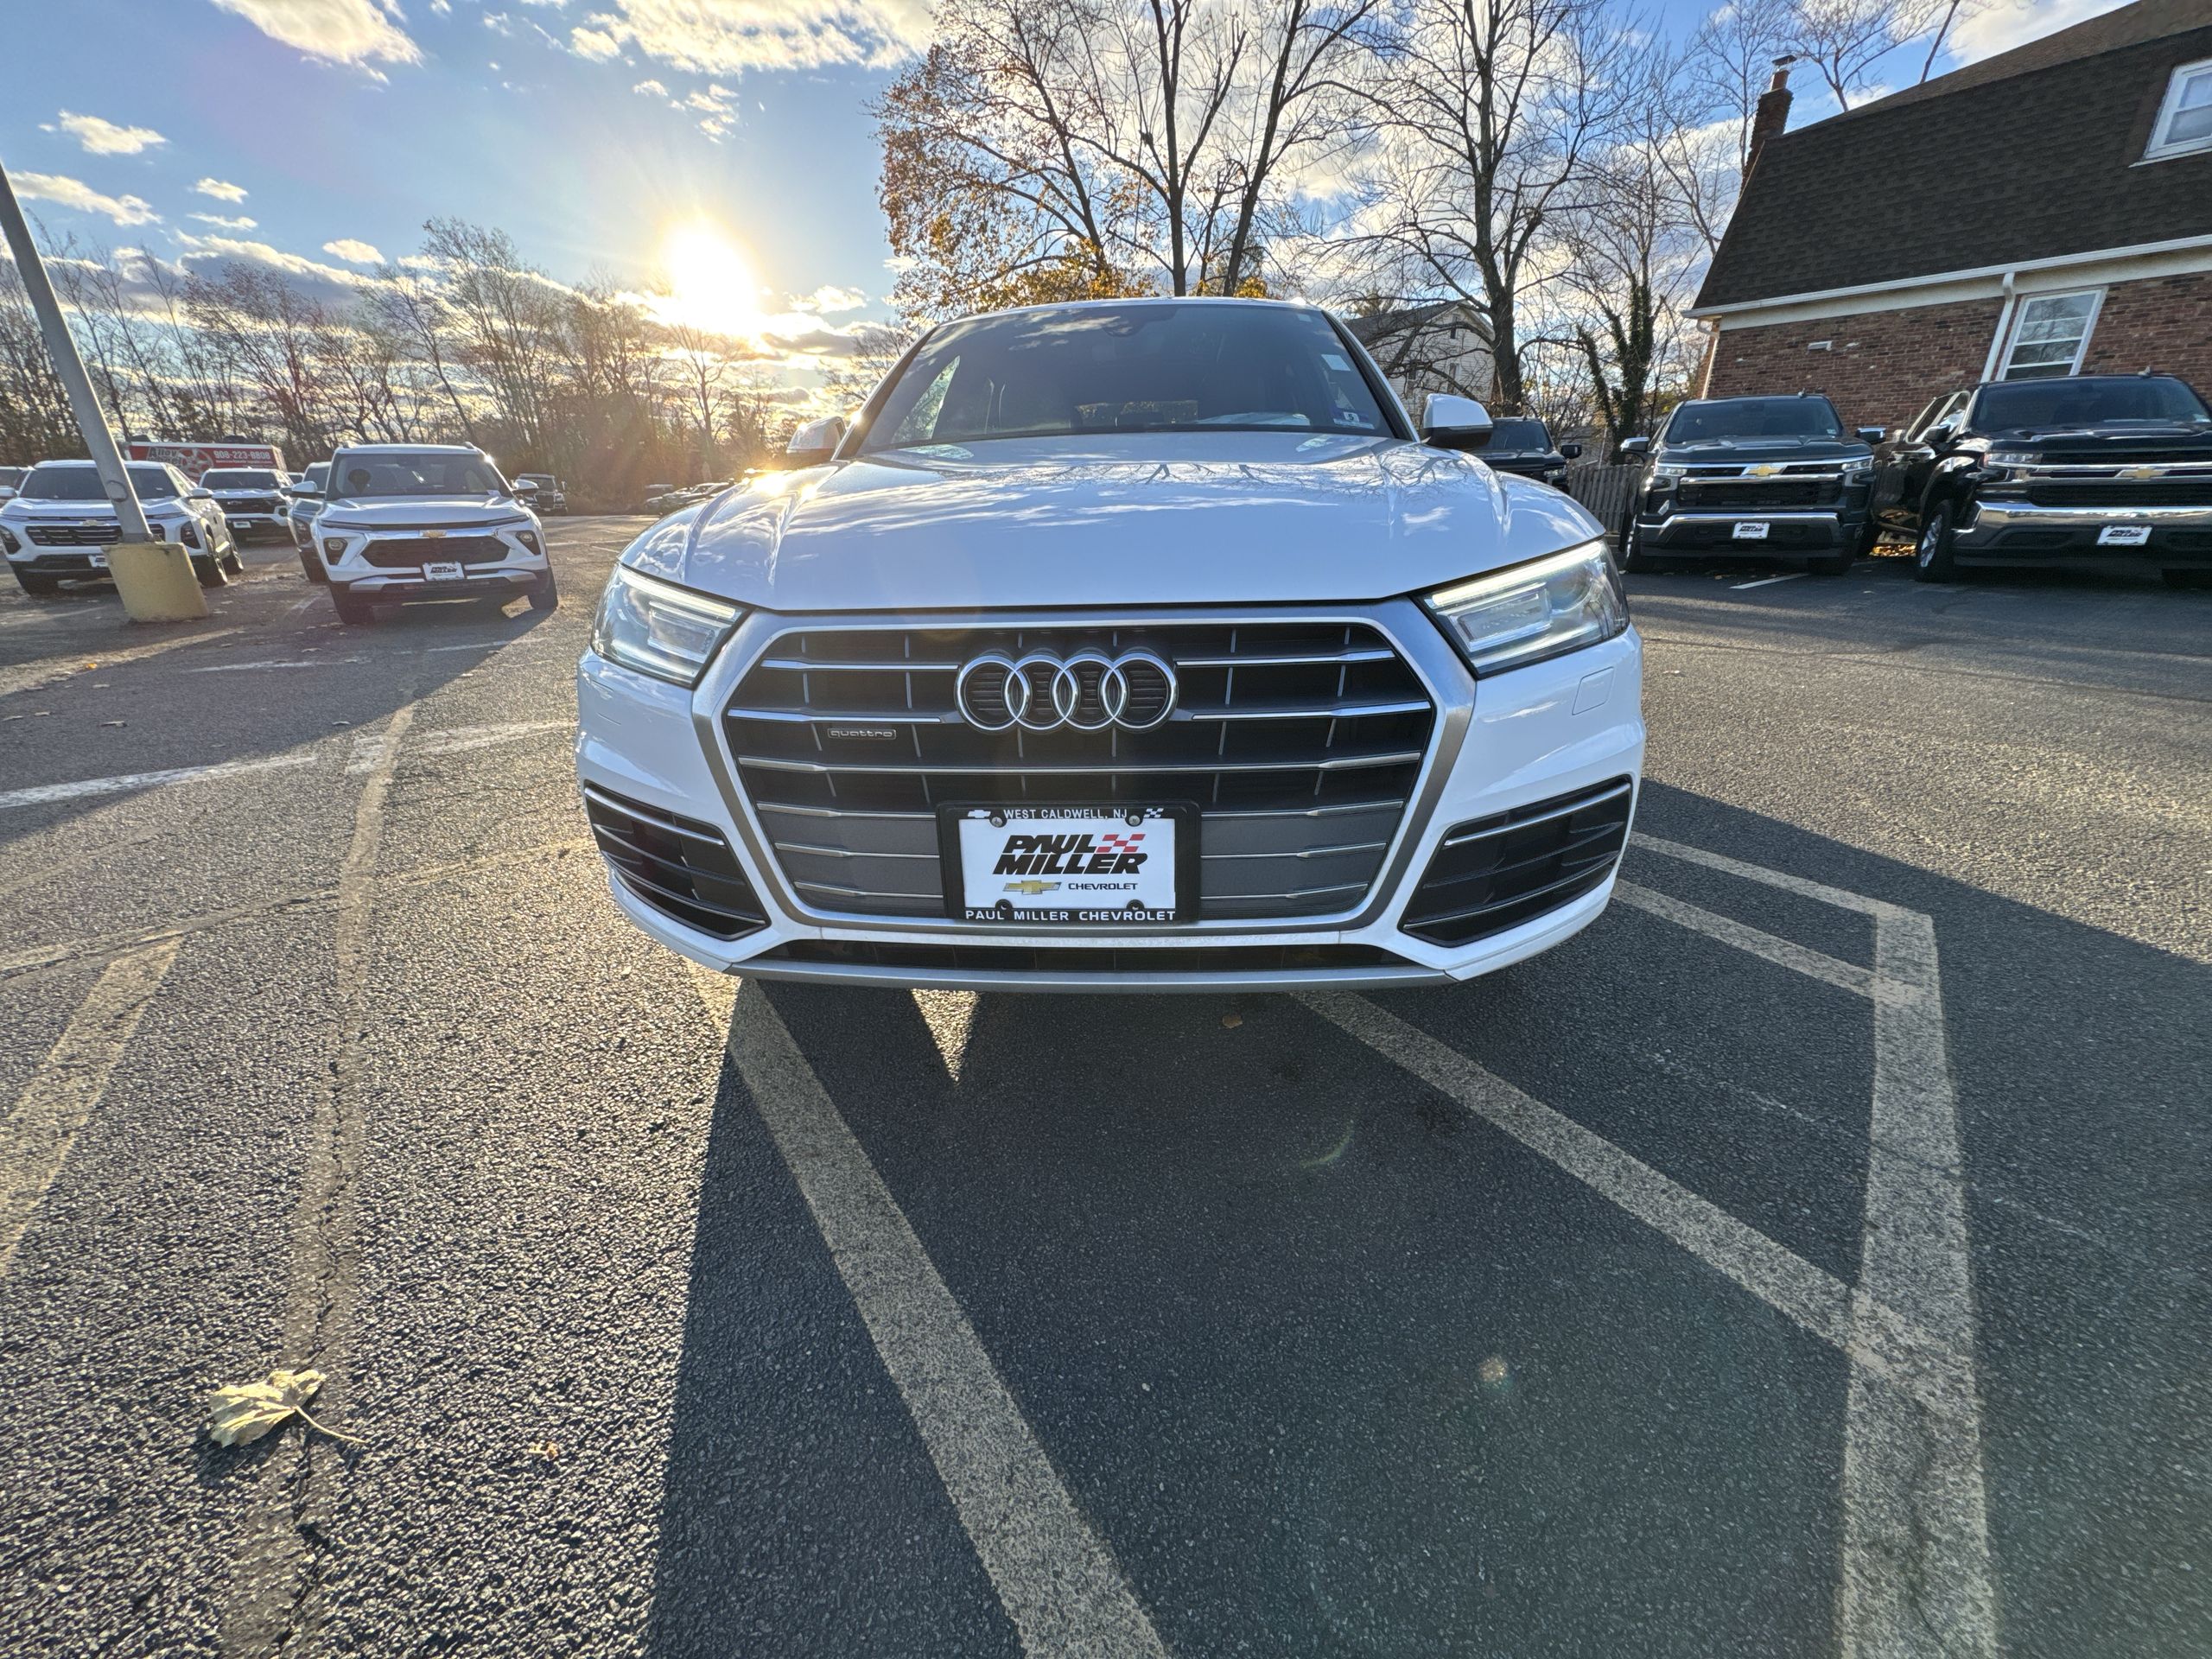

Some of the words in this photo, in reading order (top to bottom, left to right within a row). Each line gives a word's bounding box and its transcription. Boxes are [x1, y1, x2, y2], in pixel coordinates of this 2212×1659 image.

[149, 447, 179, 458] Alloy
[1003, 809, 1036, 819] WEST
[1040, 808, 1108, 820] CALDWELL,
[1113, 808, 1128, 818] NJ
[1001, 834, 1097, 855] PAUL
[992, 853, 1148, 875] MILLER
[1068, 882, 1138, 891] CHEVROLET
[965, 910, 1005, 920] PAUL
[1014, 911, 1069, 921] MILLER
[1078, 911, 1176, 921] CHEVROLET
